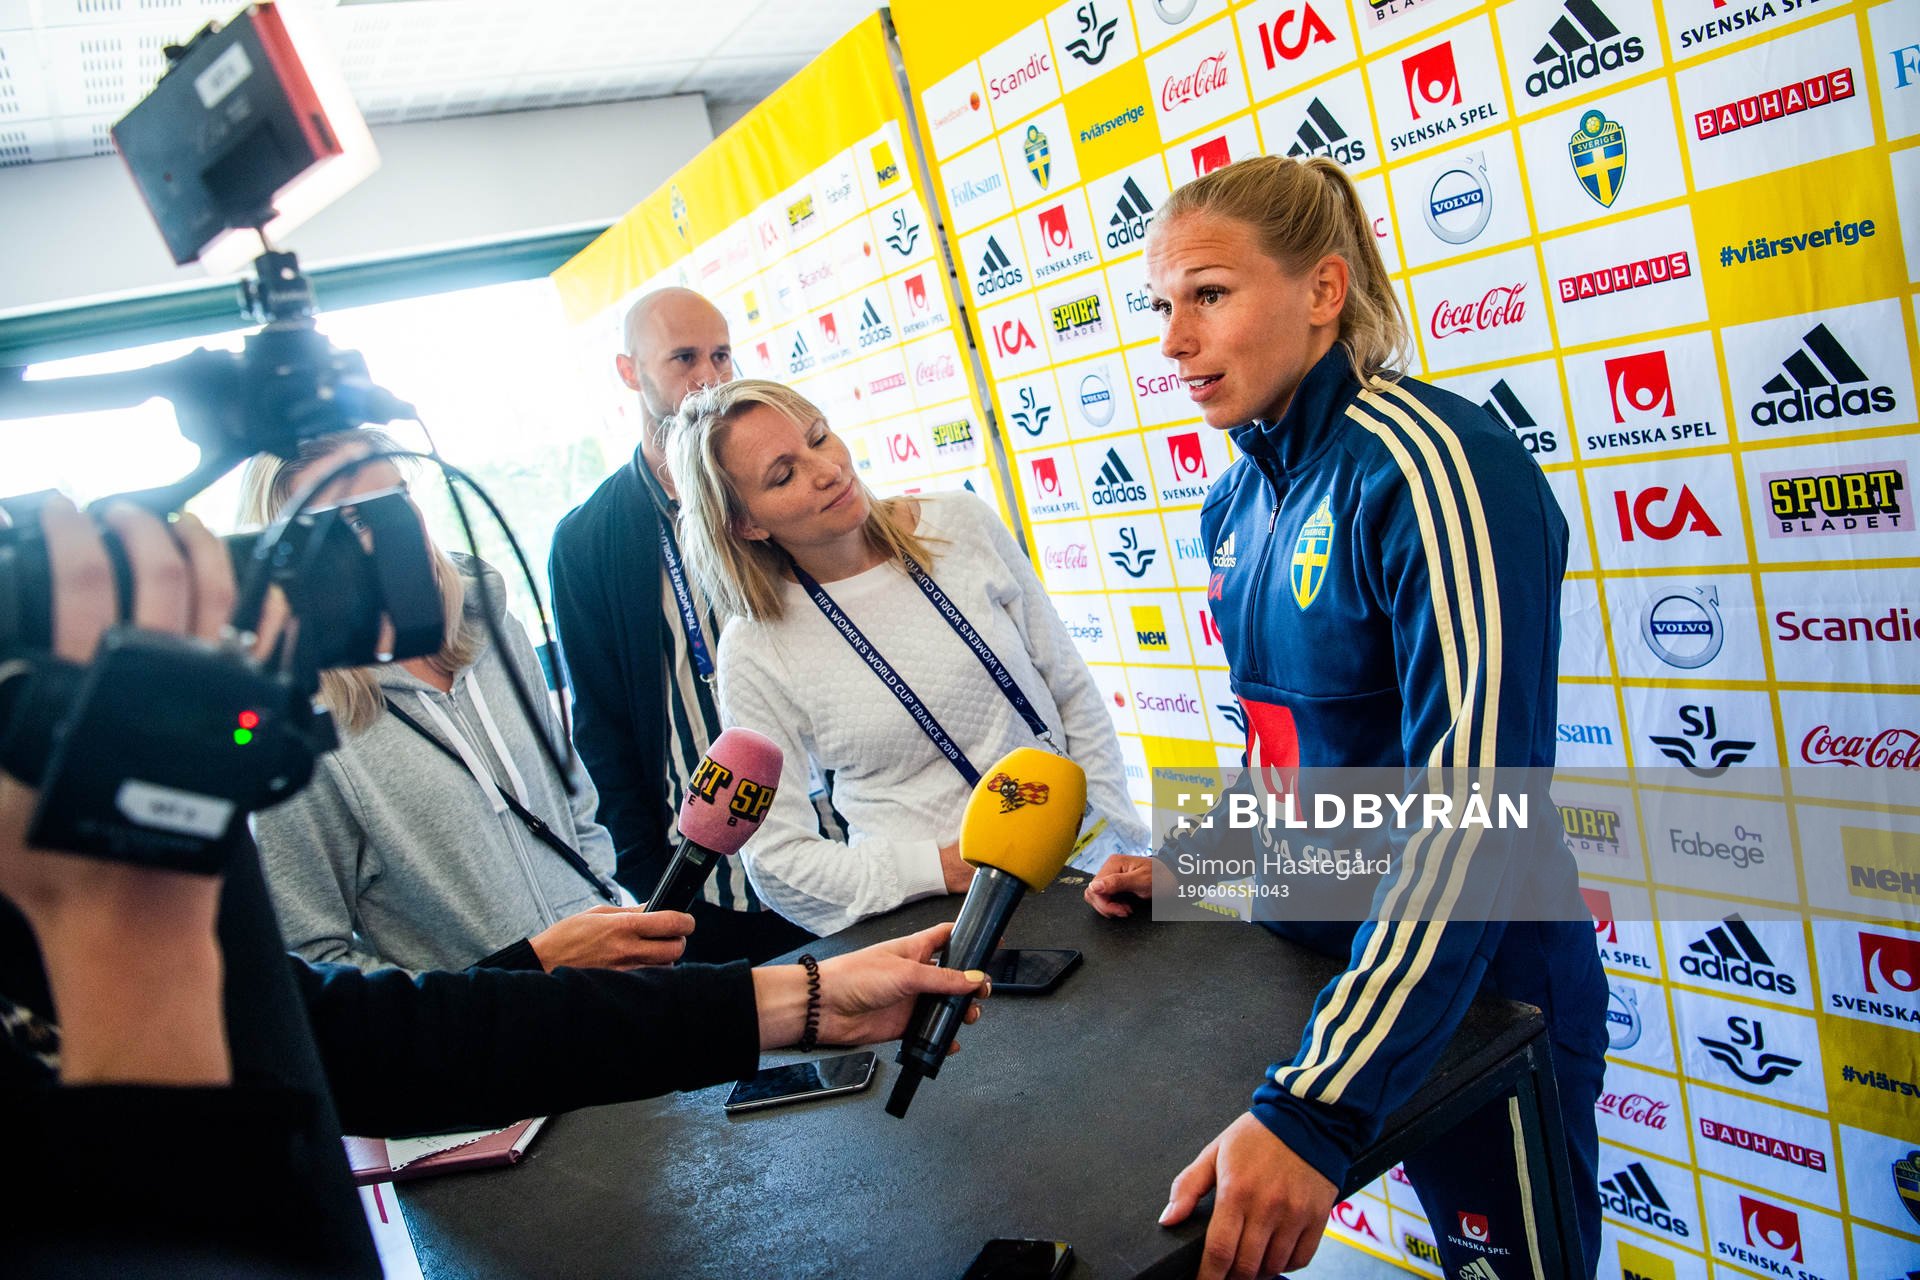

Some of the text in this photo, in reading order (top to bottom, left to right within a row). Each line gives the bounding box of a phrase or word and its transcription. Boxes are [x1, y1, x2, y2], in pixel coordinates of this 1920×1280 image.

[1076, 1, 1097, 34] SJ
[1680, 2, 1777, 48] SVENSKA
[1258, 2, 1337, 71] ICA
[989, 51, 1050, 100] Scandic
[1161, 51, 1229, 112] Coca-Cola
[1525, 36, 1645, 97] adidas
[1696, 69, 1853, 138] BAUHAUS
[1080, 104, 1145, 143] #viärsverige
[1390, 103, 1498, 151] SVENSKA SPEL
[1577, 133, 1616, 152] SVERIGE
[950, 173, 1002, 207] Folksam
[1433, 191, 1482, 213] VOLVO
[1720, 219, 1875, 267] #viärsverige
[1035, 251, 1094, 279] SVENSKA SPEL
[1560, 253, 1689, 302] BAUHAUS
[977, 268, 1023, 297] adidas
[1051, 295, 1101, 333] SPORT
[1126, 291, 1151, 313] Fab
[1431, 281, 1528, 340] Coca-Cola
[993, 320, 1037, 358] ICA
[1058, 324, 1104, 342] BLADET
[1019, 386, 1036, 410] SJ
[1082, 390, 1110, 405] VOLVO
[1137, 373, 1180, 397] Scan
[1751, 384, 1896, 426] adidas
[885, 433, 921, 464] ICA
[932, 419, 974, 447] SPORT
[1587, 421, 1717, 451] SVENSKA SPEL
[1092, 483, 1147, 506] adidas
[1162, 487, 1205, 501] SVENSKA
[1769, 469, 1904, 519] SPORT
[1614, 484, 1722, 542] ICA
[1782, 514, 1901, 533] BLADET
[1119, 527, 1138, 551] SJ
[933, 593, 962, 626] WORLD
[1654, 622, 1711, 634] VOLVO
[960, 623, 998, 669] WOMEN'S
[814, 591, 959, 760] FIFA WOMEN'S WORLD CUP FRANCE 2019
[996, 669, 1013, 689] FIFA
[1136, 692, 1199, 714] Scandic
[1678, 704, 1717, 740] SJ
[1560, 806, 1621, 844] ORT
[1566, 840, 1620, 855] ADET
[1670, 829, 1764, 869] Fabege
[1614, 951, 1652, 970] SPEL
[1680, 953, 1797, 995] adidas
[1832, 993, 1920, 1024] SVENSKA
[1727, 1016, 1764, 1049] SJ
[1842, 1064, 1920, 1098] #viärsv
[1701, 1119, 1826, 1172] BAUHAUS
[1447, 1235, 1511, 1255] SVENSKA SPEL
[1718, 1241, 1794, 1279] SVENSKA
